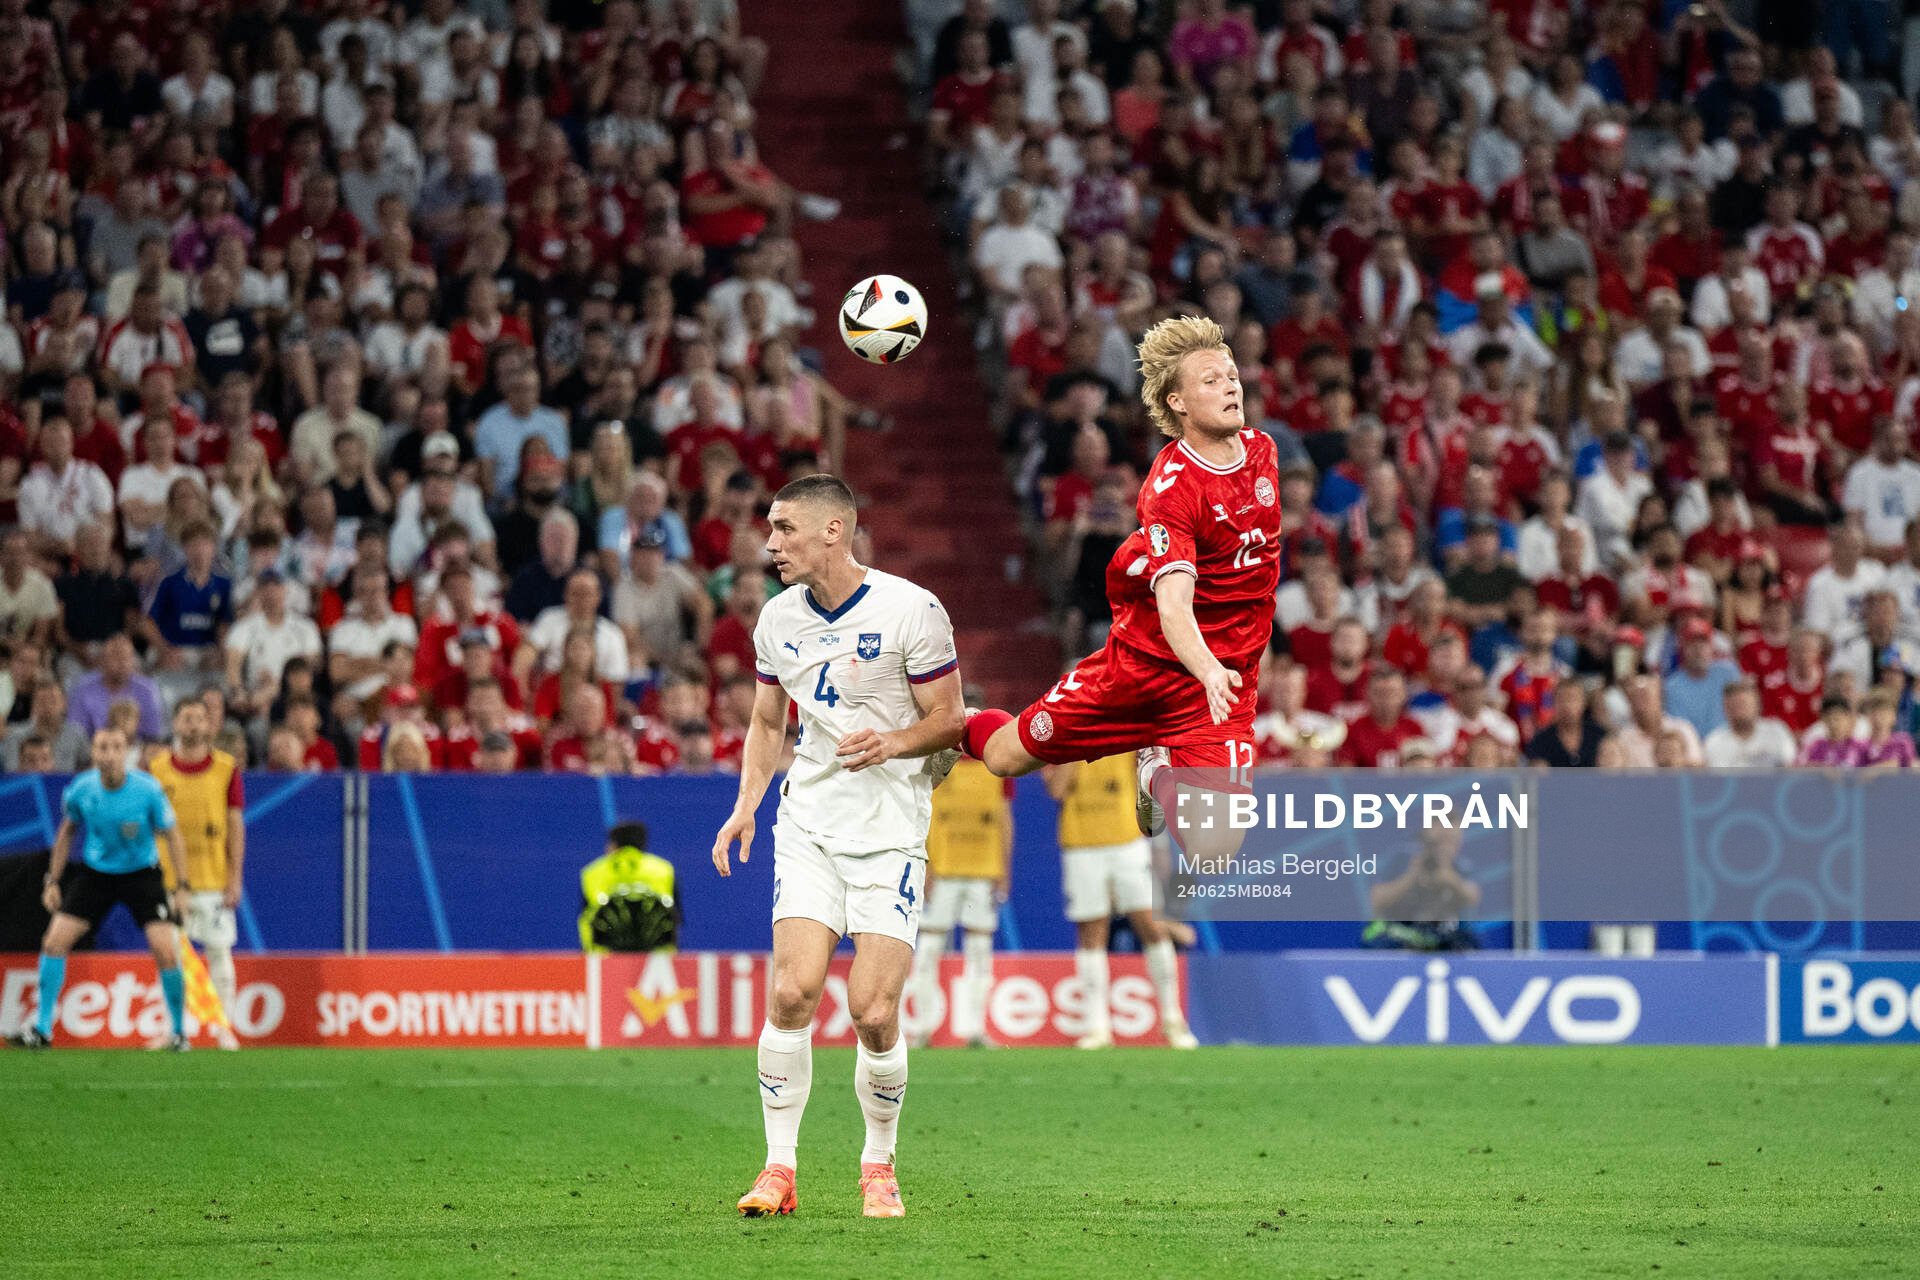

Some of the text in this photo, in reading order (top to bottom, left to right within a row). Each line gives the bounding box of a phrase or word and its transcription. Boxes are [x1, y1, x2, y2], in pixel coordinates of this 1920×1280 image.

[1233, 528, 1267, 569] 12
[814, 661, 839, 708] 4
[1225, 739, 1253, 789] 12
[898, 861, 916, 906] 4
[0, 968, 286, 1038] Betao
[317, 991, 587, 1036] SPORTWETTEN
[1323, 958, 1642, 1043] vivo
